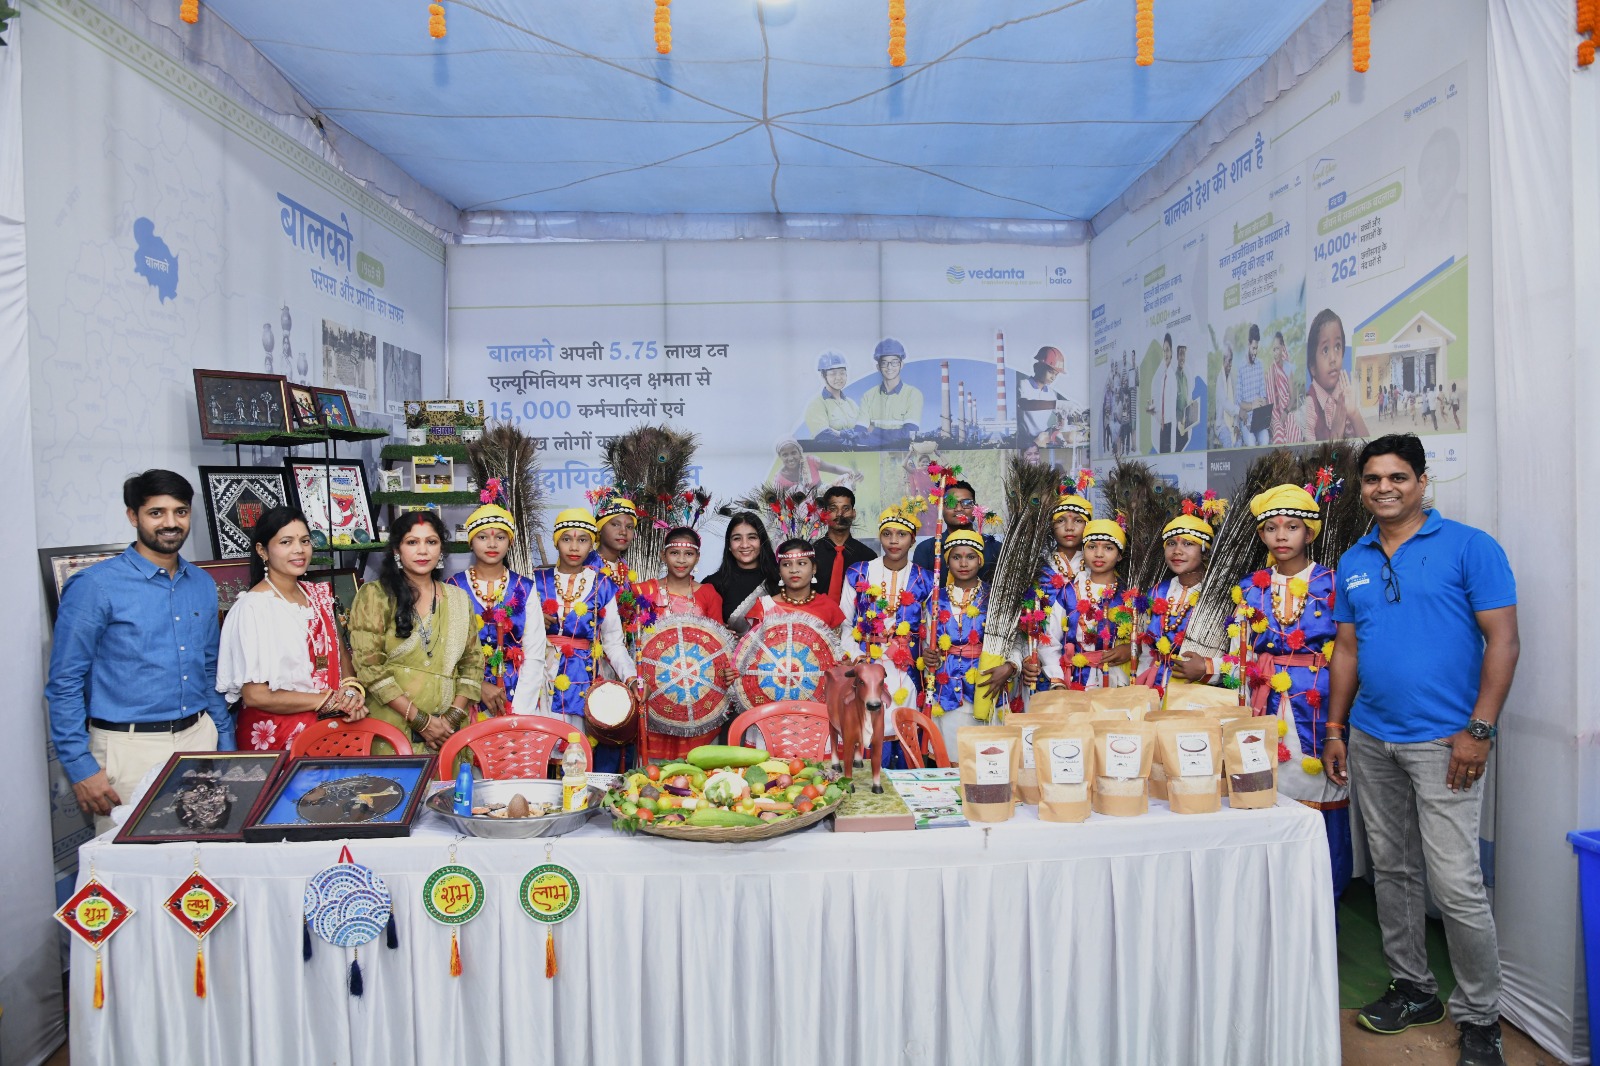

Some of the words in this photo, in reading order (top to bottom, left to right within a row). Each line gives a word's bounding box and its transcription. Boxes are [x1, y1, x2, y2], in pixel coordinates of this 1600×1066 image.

[1164, 184, 1194, 227] बालको
[1195, 180, 1211, 210] देश
[1212, 162, 1227, 194] की
[1230, 149, 1253, 184] शान
[1255, 131, 1265, 170] है
[276, 190, 354, 273] बालको
[1264, 226, 1284, 245] माध्यम
[1313, 231, 1357, 262] 14,000+
[145, 256, 169, 274] बालको
[968, 267, 1025, 280] vedanta
[1331, 255, 1357, 284] 262
[1049, 277, 1073, 285] balco
[310, 266, 337, 297] परंपरा
[339, 275, 355, 304] और
[355, 287, 376, 312] प्रगति
[376, 297, 388, 318] का
[388, 303, 405, 325] सफर
[487, 338, 555, 363] बालको
[559, 340, 604, 361] अपनी
[609, 340, 659, 361] 5.75
[664, 344, 703, 360] लाख
[706, 343, 730, 359] टन
[488, 369, 582, 395] एल्यूमिनियम
[586, 373, 643, 391] उत्पादन
[647, 371, 692, 388] क्षमता
[695, 366, 713, 387] से
[490, 400, 572, 424] 15,000
[577, 397, 659, 420] कर्मचारियों
[661, 397, 686, 419] एवं
[552, 430, 593, 452] लोगों
[440, 883, 472, 914] शुभ
[532, 883, 569, 911] लाभ
[85, 906, 109, 926] शुभ
